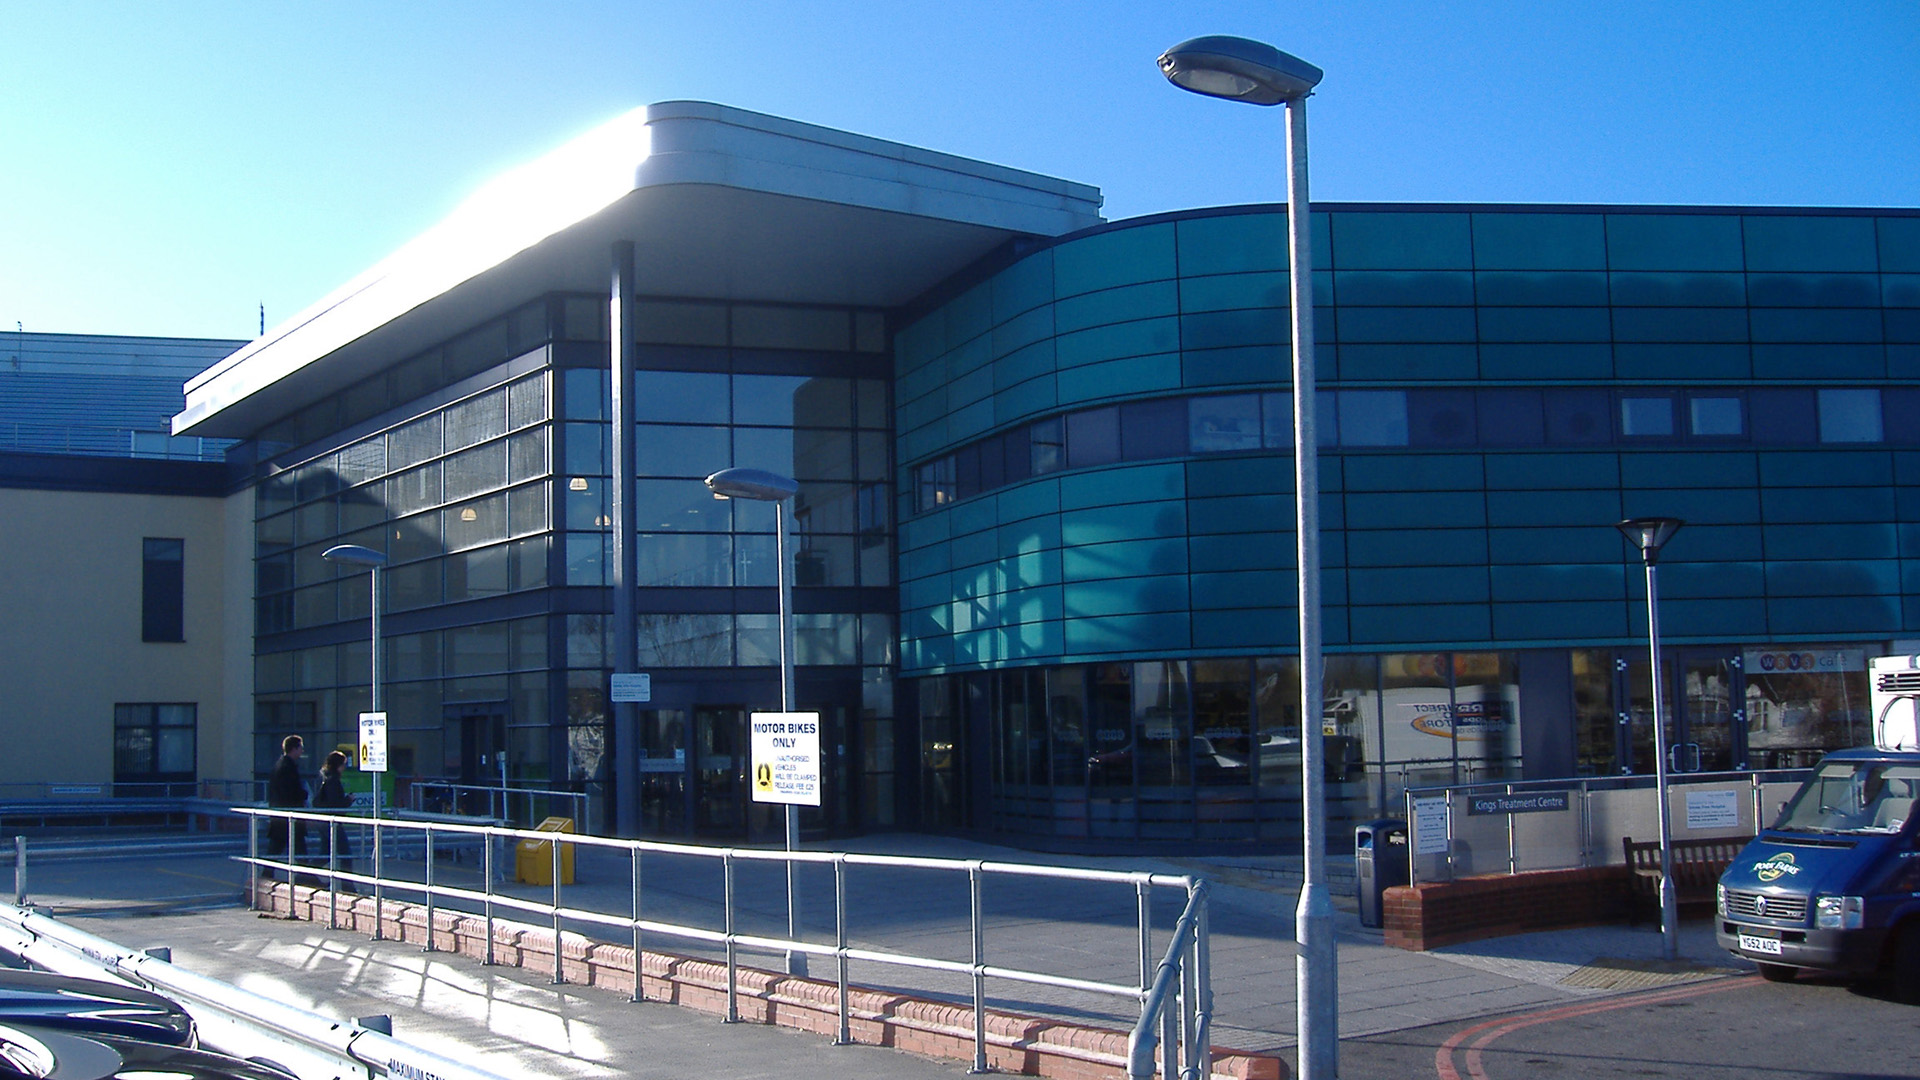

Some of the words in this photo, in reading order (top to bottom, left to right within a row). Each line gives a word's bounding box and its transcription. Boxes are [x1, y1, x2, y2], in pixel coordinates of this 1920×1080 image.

[1762, 655, 1813, 670] WRVS
[754, 723, 785, 733] MOTOR
[788, 723, 816, 734] BIKES
[772, 738, 796, 748] ONLY
[1475, 800, 1497, 812] Kings
[1498, 799, 1537, 809] Treatment
[1538, 797, 1564, 807] Centre
[1742, 936, 1760, 950] YG52
[387, 1058, 425, 1080] MAXIMUM
